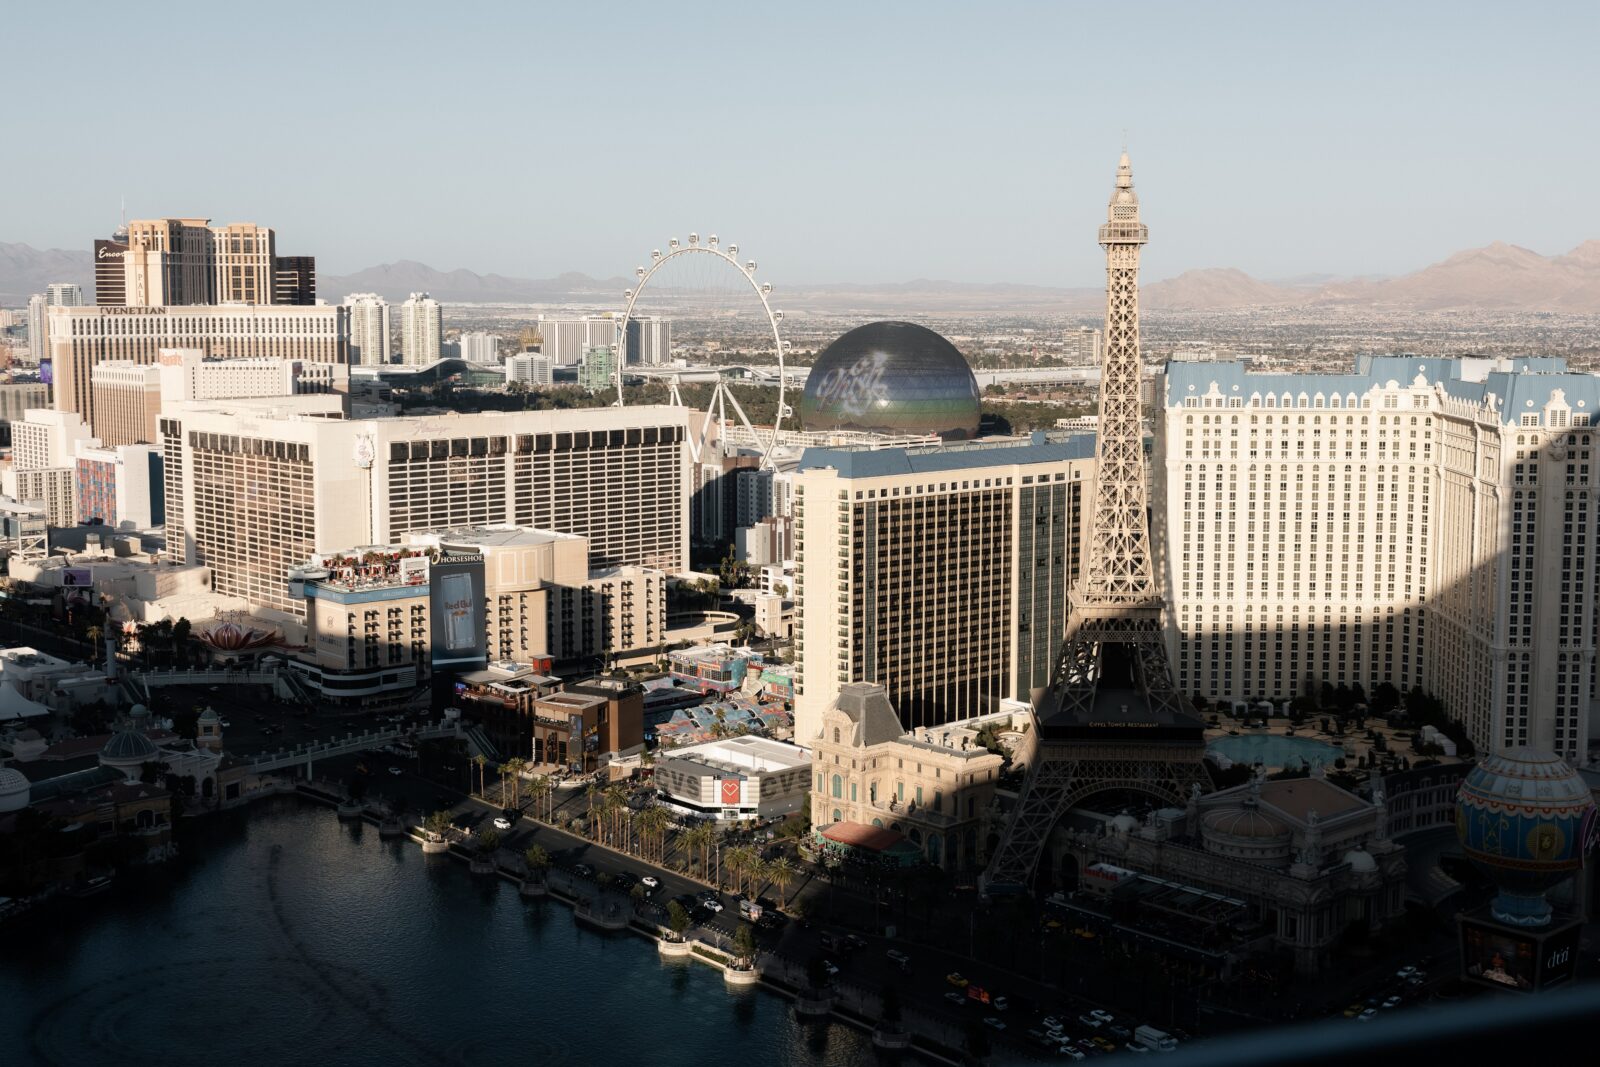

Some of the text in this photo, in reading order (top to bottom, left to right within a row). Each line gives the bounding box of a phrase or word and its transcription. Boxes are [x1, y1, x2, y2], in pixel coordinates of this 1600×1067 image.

[98, 246, 126, 259] Encor
[105, 307, 167, 315] VENETIAN
[440, 554, 484, 563] HORSESHOE
[655, 767, 700, 799] CVS
[760, 768, 812, 799] CVS
